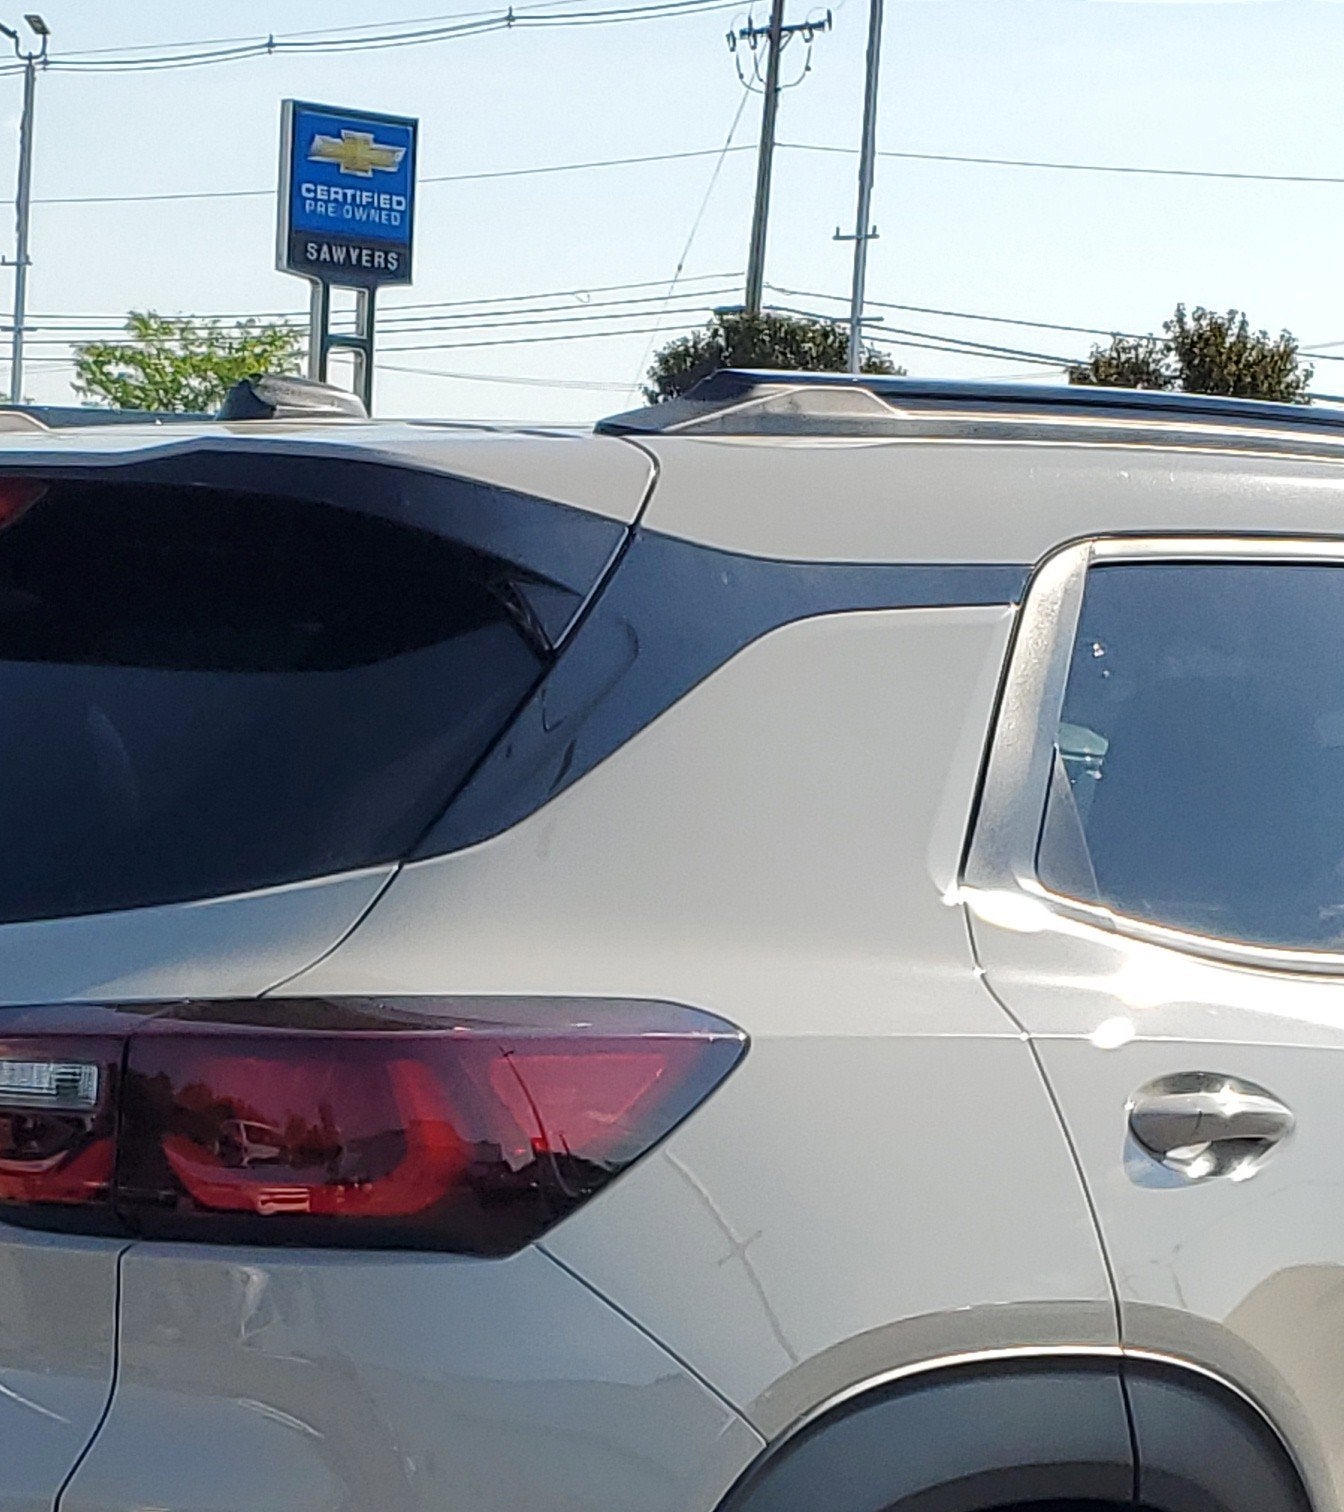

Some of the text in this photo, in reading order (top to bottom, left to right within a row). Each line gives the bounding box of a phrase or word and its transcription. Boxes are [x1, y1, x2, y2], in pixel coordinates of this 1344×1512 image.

[300, 182, 406, 212] CERTIFIED
[342, 204, 402, 227] OWNED
[306, 242, 399, 271] SAWYERS
